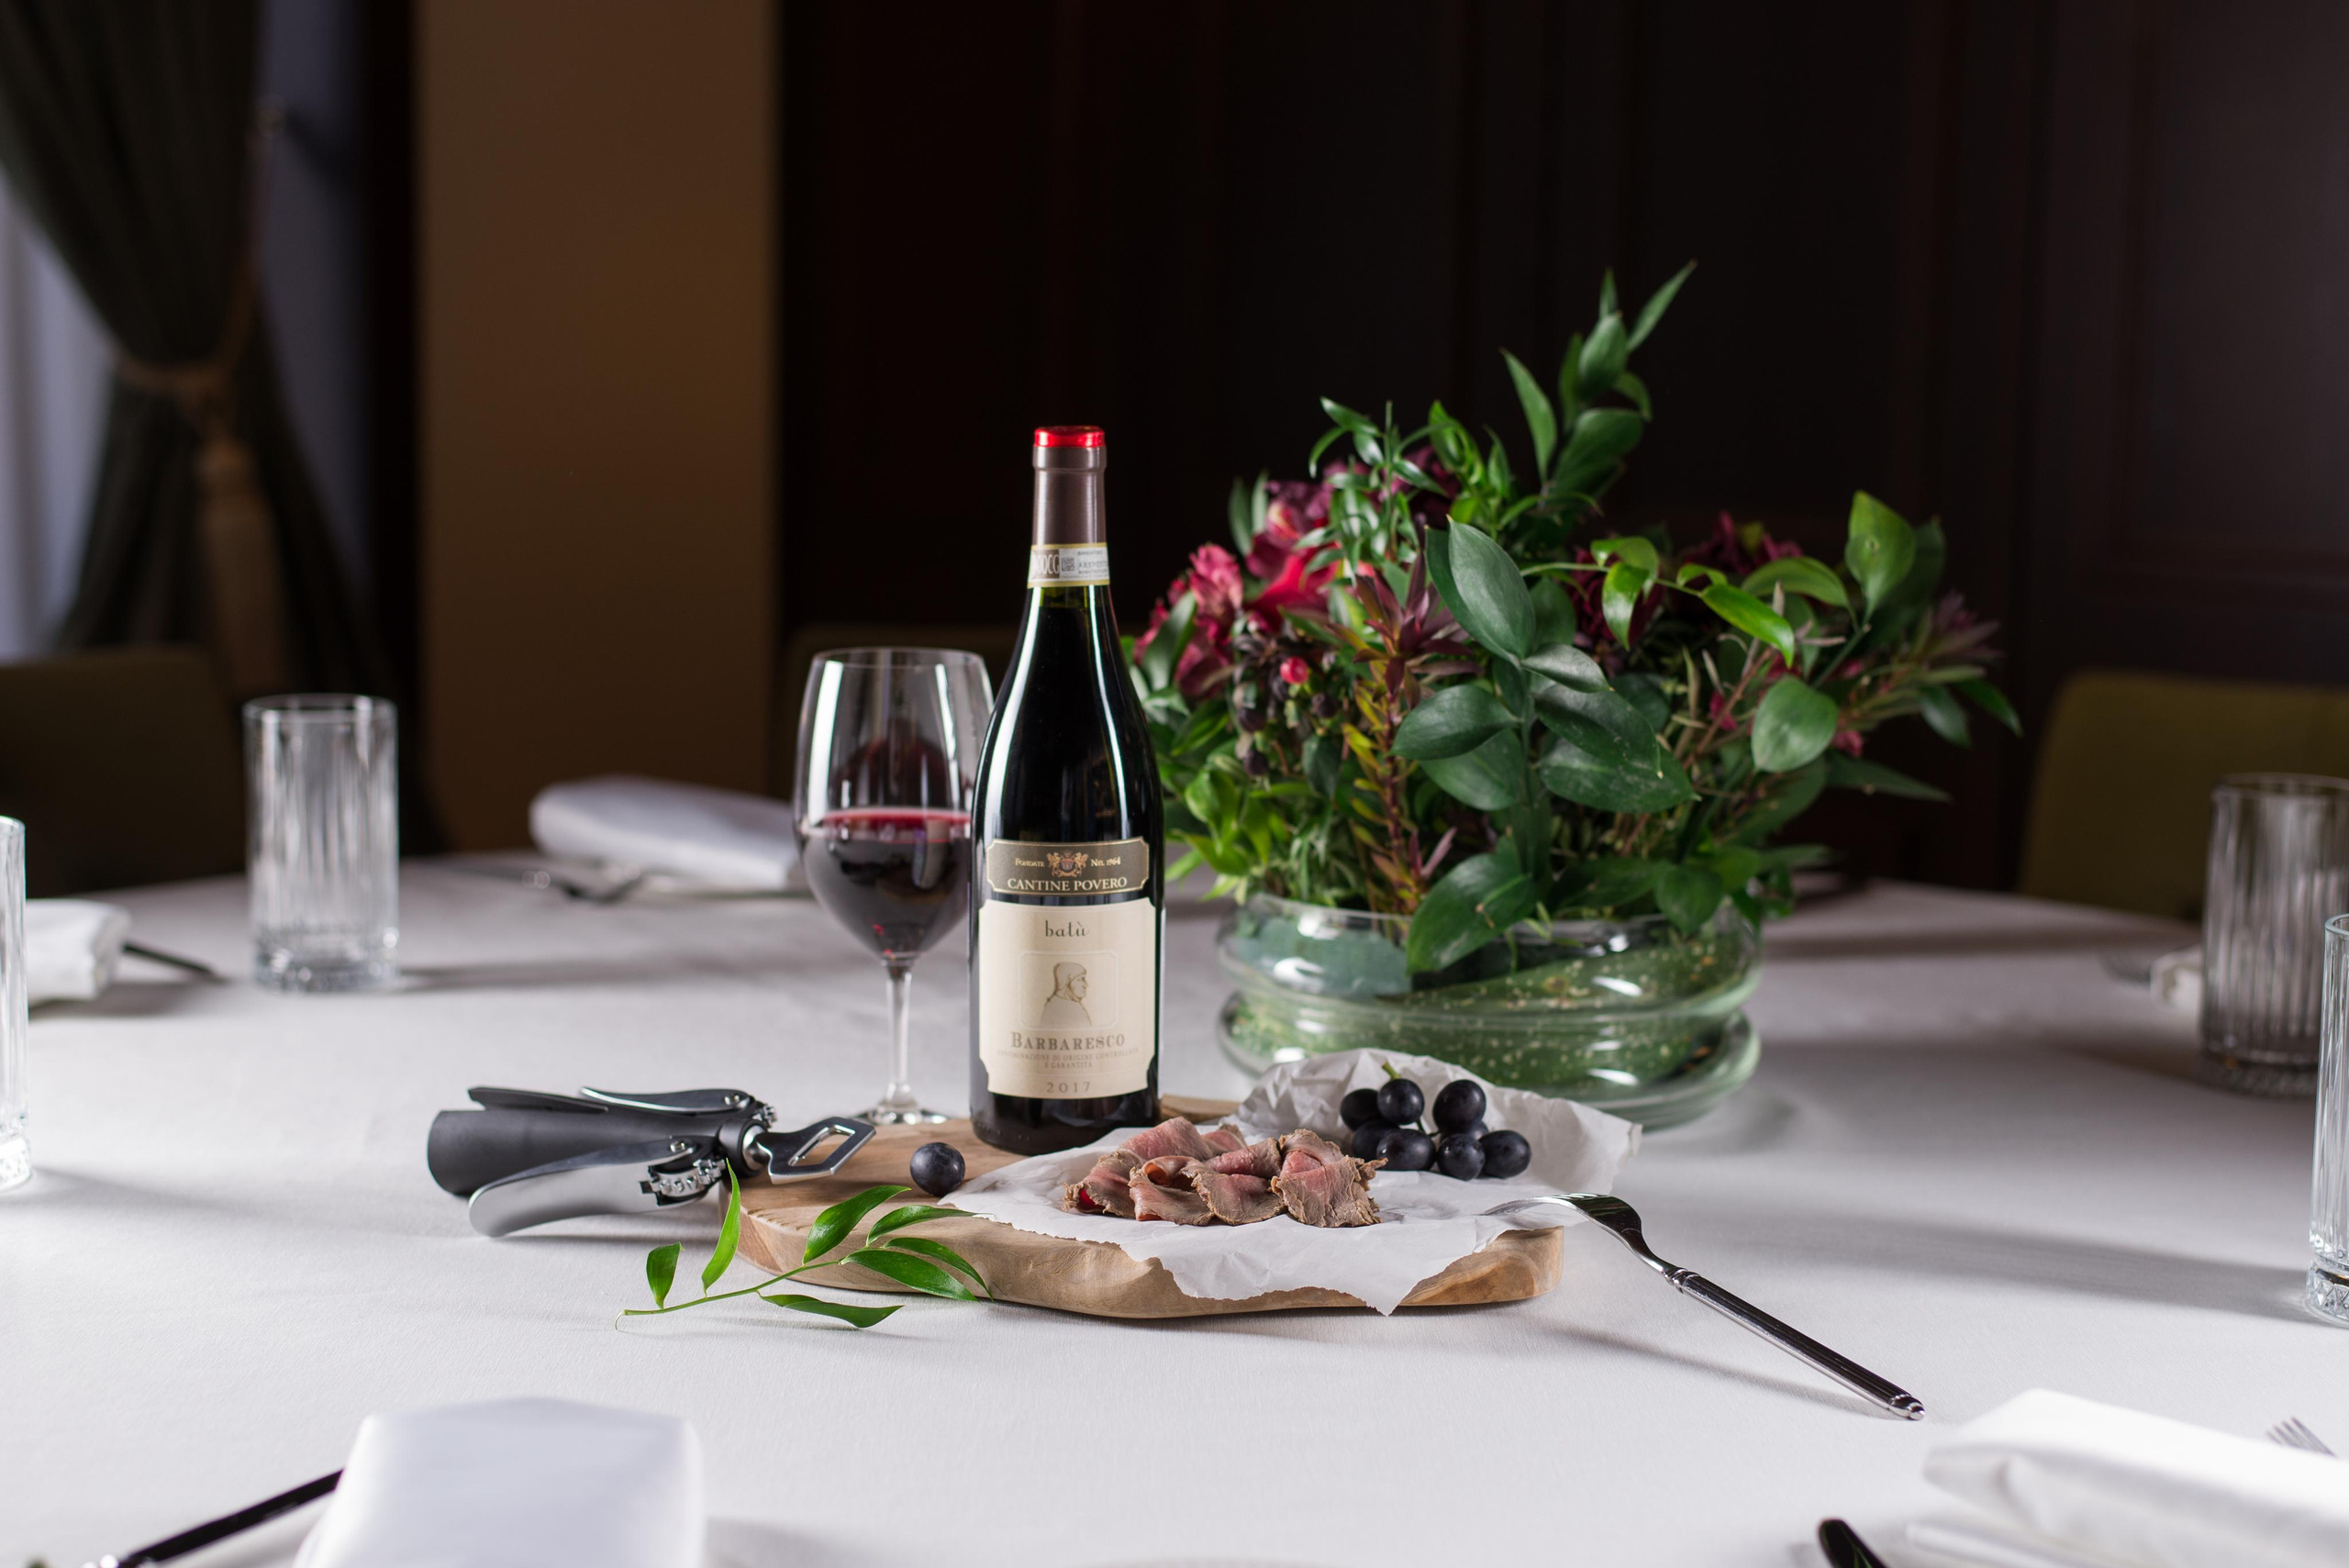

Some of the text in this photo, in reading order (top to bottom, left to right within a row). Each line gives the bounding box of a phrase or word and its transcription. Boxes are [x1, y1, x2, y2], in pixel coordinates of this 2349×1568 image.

[1008, 876, 1128, 891] CANTINE POVERO
[1045, 919, 1090, 937] batù
[1011, 1032, 1125, 1051] BARBARESCO
[1063, 1053, 1093, 1062] ORIGINE
[1096, 1047, 1139, 1060] CONTROLLATA
[1046, 1082, 1091, 1093] 2017
